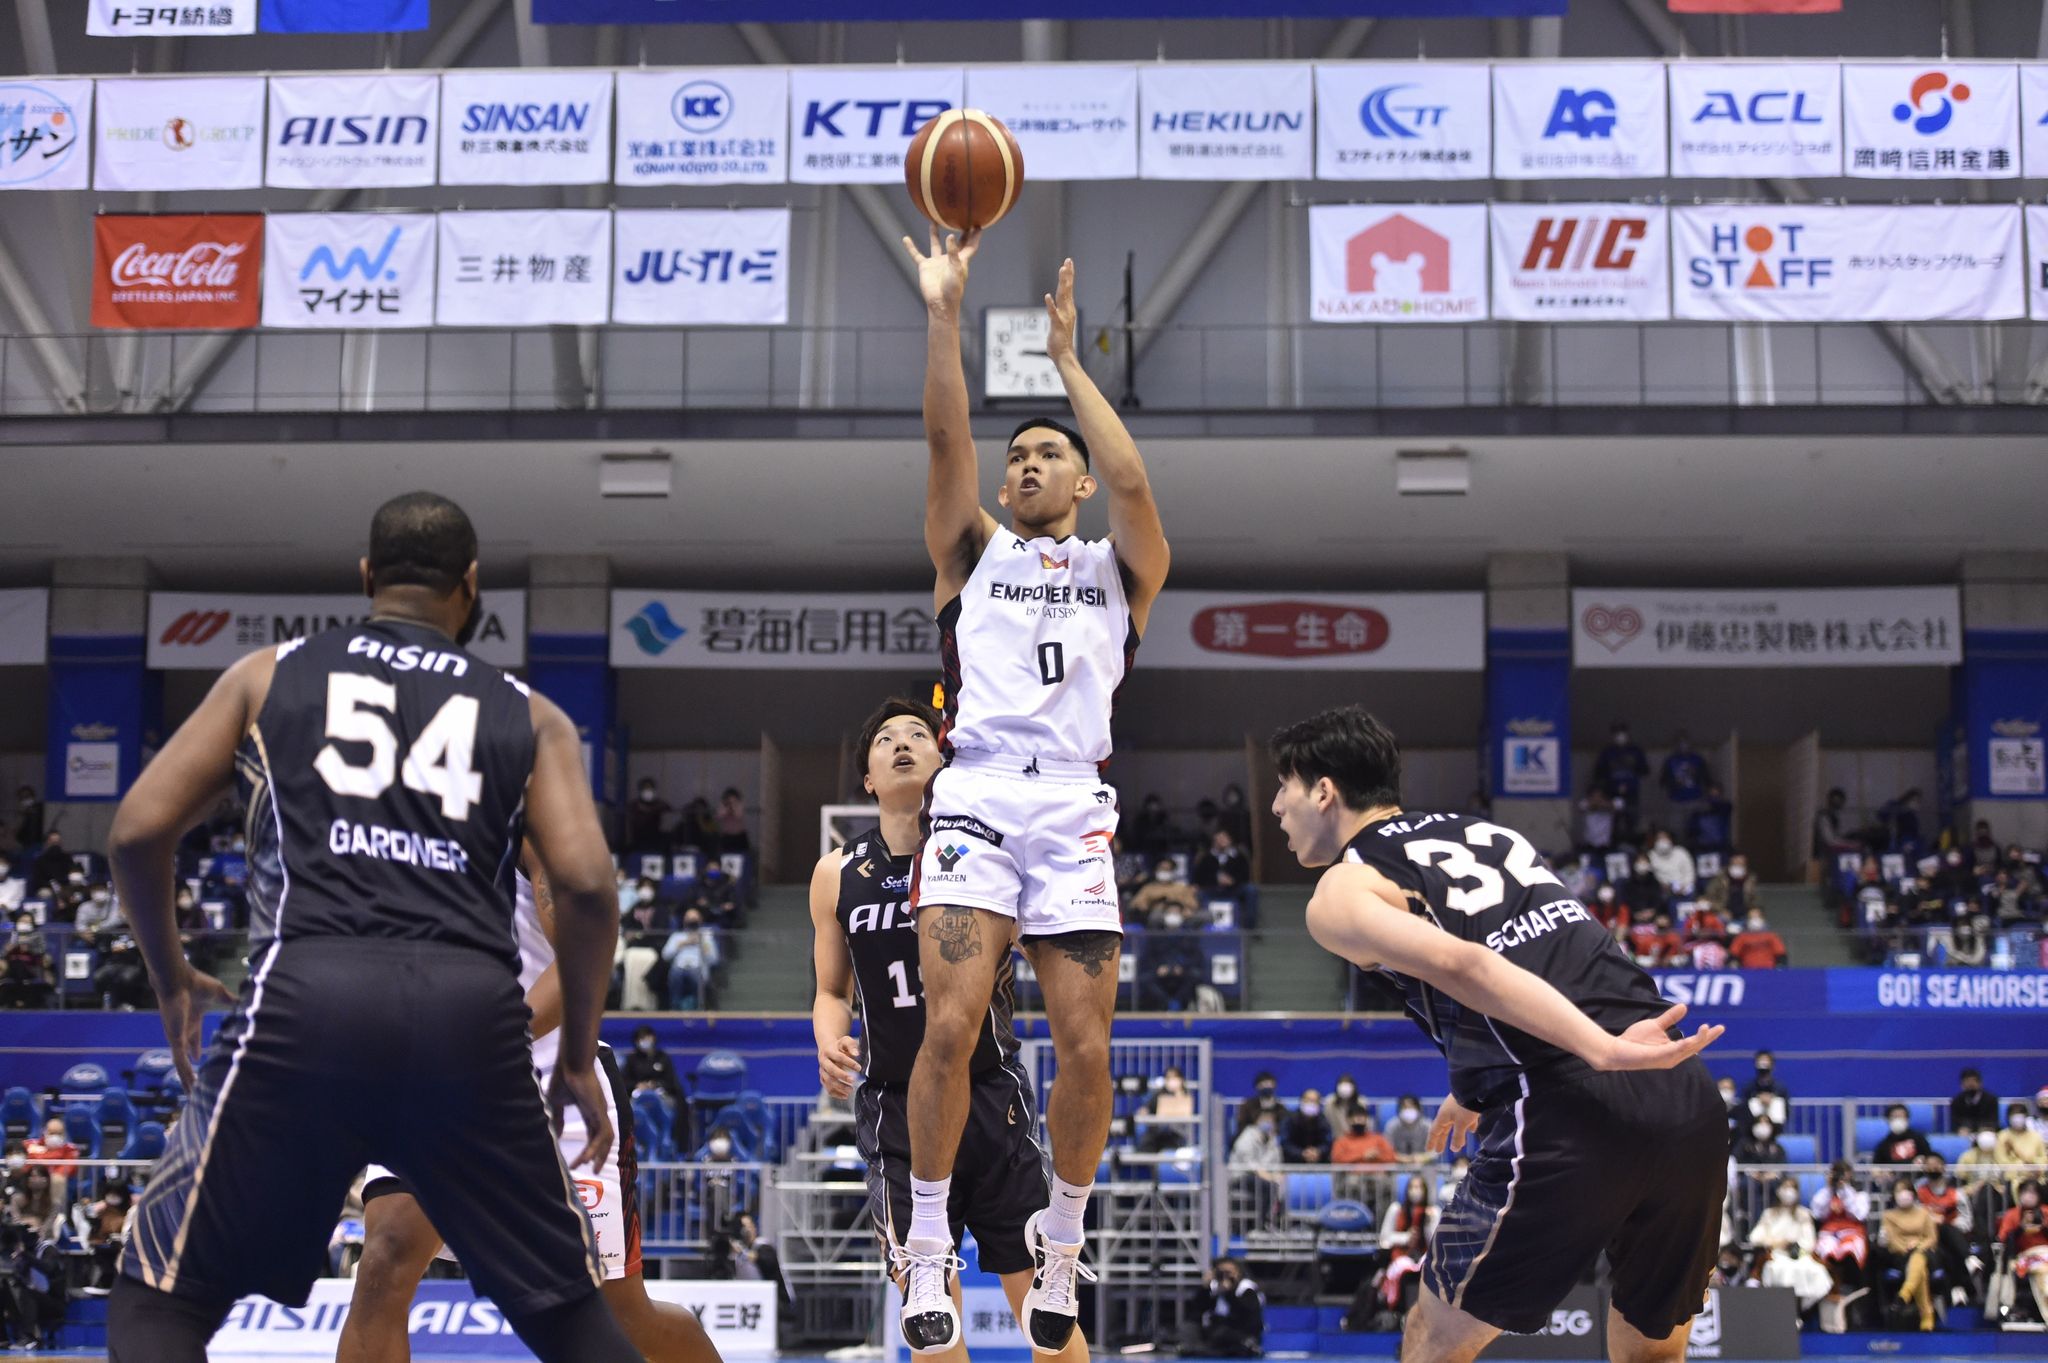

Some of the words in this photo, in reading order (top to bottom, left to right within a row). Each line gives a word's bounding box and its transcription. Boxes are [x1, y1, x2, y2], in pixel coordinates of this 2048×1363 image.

[111, 7, 233, 26] トヨタ紡織
[462, 103, 588, 132] SINSAN
[802, 101, 953, 137] KTB
[1152, 111, 1302, 132] HEKIUN
[1692, 92, 1823, 123] ACL
[0, 127, 76, 162] サン
[106, 128, 160, 142] PRIDE
[201, 127, 255, 142] GROUP
[111, 242, 248, 287] Coca-Cola
[456, 254, 592, 283] 三井物産
[1848, 254, 2004, 272] ホットスタッフグループ
[300, 286, 401, 314] マイナビ
[1026, 606, 1039, 616] by
[1042, 605, 1081, 619] GATSBY
[700, 606, 945, 653] 碧海信用金
[1211, 612, 1368, 648] 第一生命
[1655, 617, 1951, 653] 伊藤忠製糖株式会社
[1037, 641, 1065, 685] 0
[312, 671, 483, 822] 54
[329, 818, 470, 874] GARDNER
[927, 873, 967, 883] YAMAZEN
[1403, 821, 1566, 917] 32
[849, 902, 915, 934] AIS
[1485, 899, 1592, 953] SCHAFER
[888, 960, 924, 1009] 1
[1878, 973, 1920, 1007] GO!
[1926, 973, 2048, 1007] SEAHORSE
[714, 1304, 763, 1331] 三好
[1550, 1309, 1594, 1336] 5G
